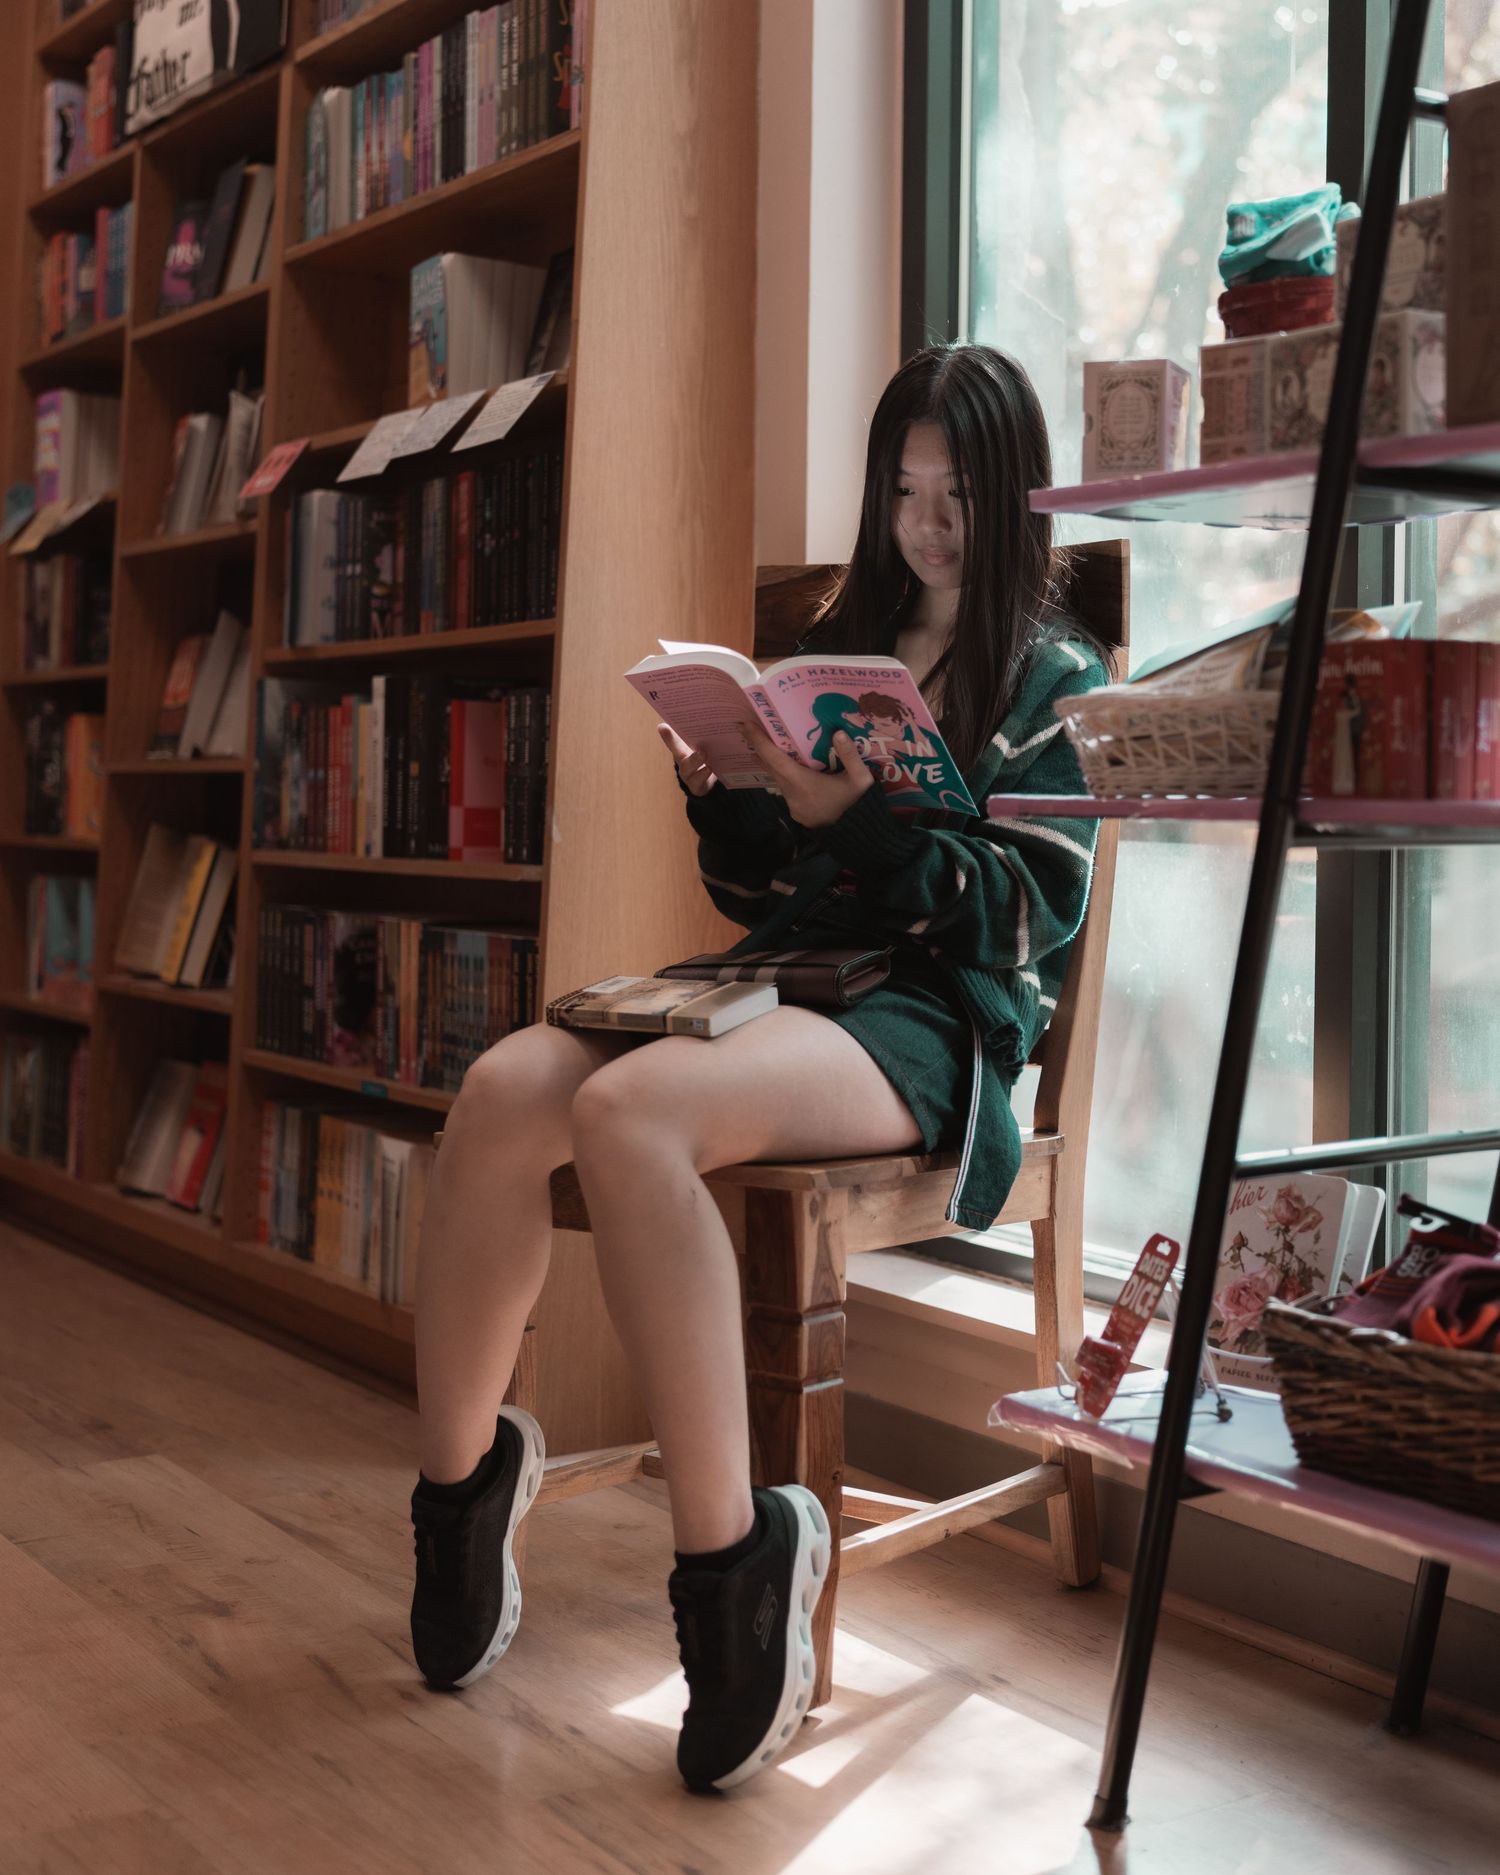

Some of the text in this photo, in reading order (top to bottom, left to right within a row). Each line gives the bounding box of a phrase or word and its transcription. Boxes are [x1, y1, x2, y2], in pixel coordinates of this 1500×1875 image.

[778, 668, 902, 688] ALI HAZELWOOD
[763, 710, 777, 718] IN
[904, 740, 934, 757] IN
[880, 762, 945, 784] OVE
[1229, 1180, 1268, 1215] hier
[1120, 1278, 1160, 1318] DICE
